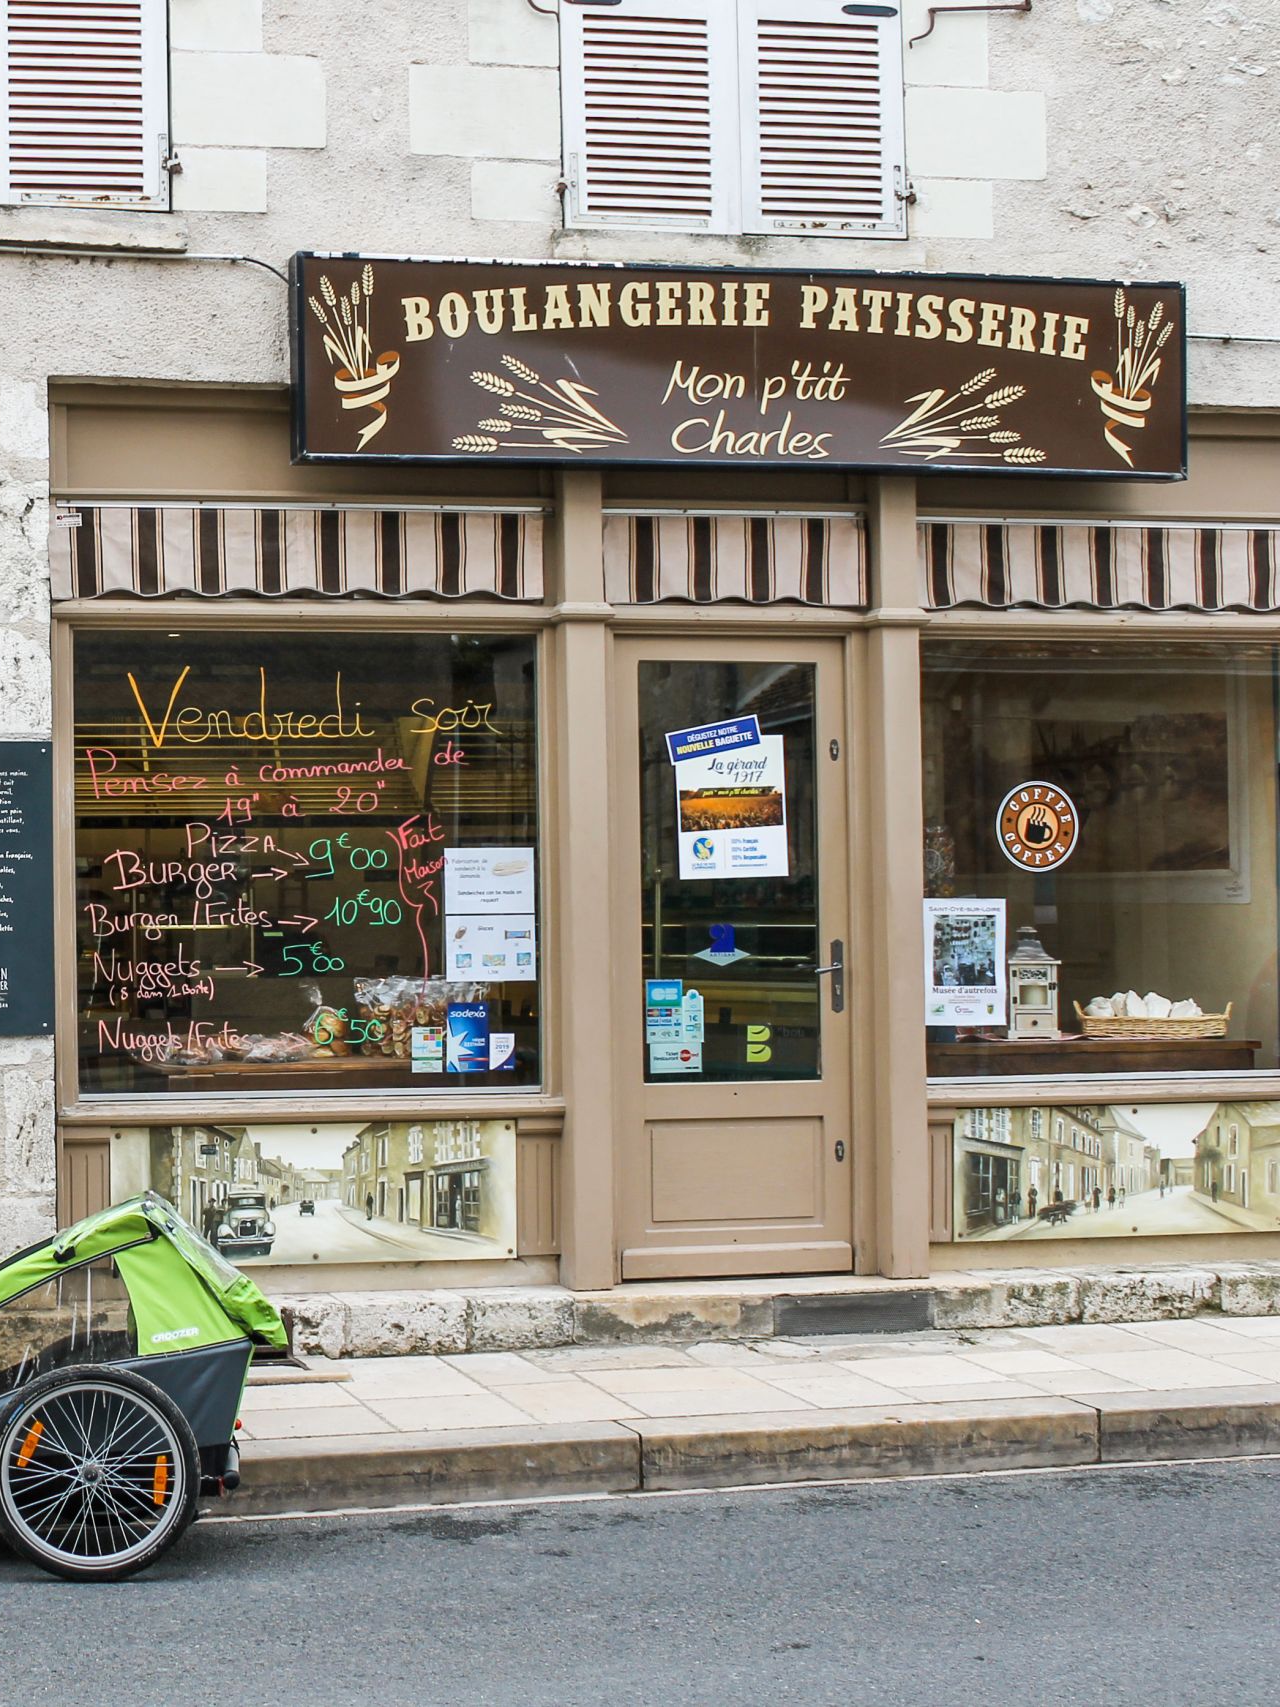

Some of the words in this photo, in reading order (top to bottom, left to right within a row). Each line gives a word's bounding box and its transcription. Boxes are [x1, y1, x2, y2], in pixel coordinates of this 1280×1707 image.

[400, 281, 772, 343] BOULANGERIE
[799, 283, 1091, 362] PATISSERIE
[660, 360, 746, 403] Mon
[760, 358, 851, 415] p'tit
[668, 411, 833, 460] Charles
[126, 664, 376, 748] Vendredi
[676, 739, 715, 755] NOUVELLE
[714, 731, 754, 747] BAGUETTE
[686, 728, 718, 743] DÉGUSTEZ
[718, 725, 739, 736] NOTRE
[86, 748, 209, 800] Pensez
[224, 765, 245, 787] à
[259, 747, 413, 783] commander
[434, 740, 470, 766] de
[707, 757, 724, 775] La
[733, 770, 764, 783] 1917
[281, 795, 307, 818] à
[1009, 788, 1072, 823] COFFEE
[397, 813, 446, 850] Fait
[404, 855, 448, 884] Maison
[93, 942, 201, 989] Nuggets
[932, 986, 956, 994] Musée
[958, 986, 998, 994] d'autrefois
[449, 1009, 486, 1018] sodexo
[152, 1327, 200, 1344] CROOZER
